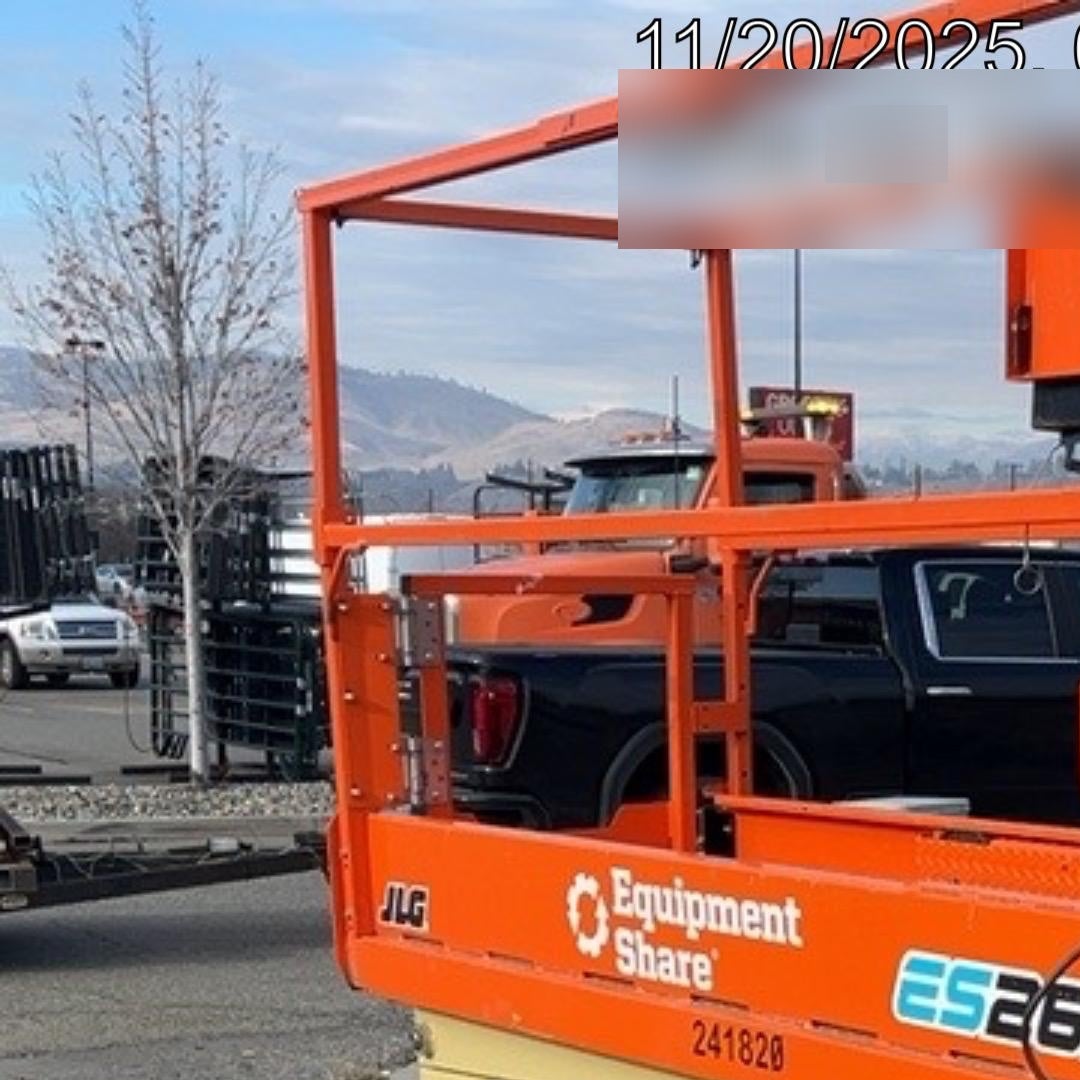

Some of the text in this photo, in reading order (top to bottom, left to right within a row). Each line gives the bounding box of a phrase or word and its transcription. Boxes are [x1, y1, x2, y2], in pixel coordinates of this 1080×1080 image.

[381, 886, 427, 929] JLG
[611, 868, 803, 947] Equipment
[614, 928, 714, 990] Share
[692, 1020, 784, 1072] 241820
